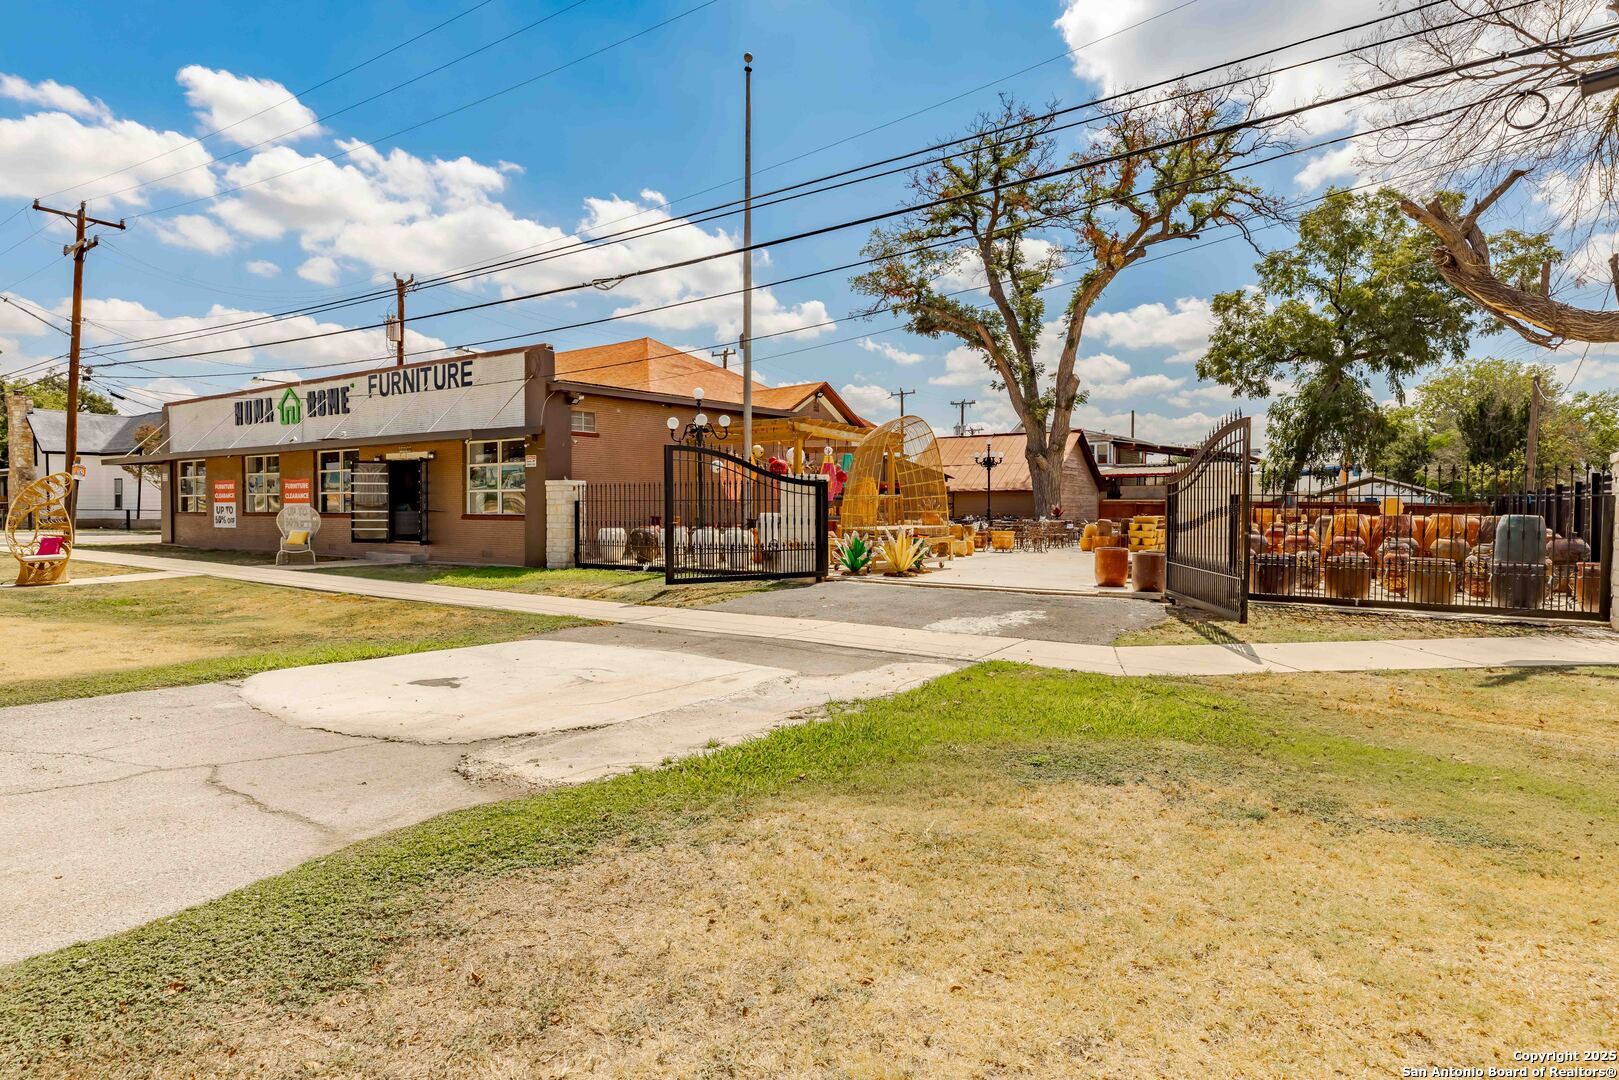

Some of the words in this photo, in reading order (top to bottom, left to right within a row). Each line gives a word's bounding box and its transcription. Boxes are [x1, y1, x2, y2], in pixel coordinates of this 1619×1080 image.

[306, 386, 350, 417] HOME
[368, 361, 473, 398] FURNITURE
[216, 506, 224, 514] UP
[225, 506, 233, 514] TO
